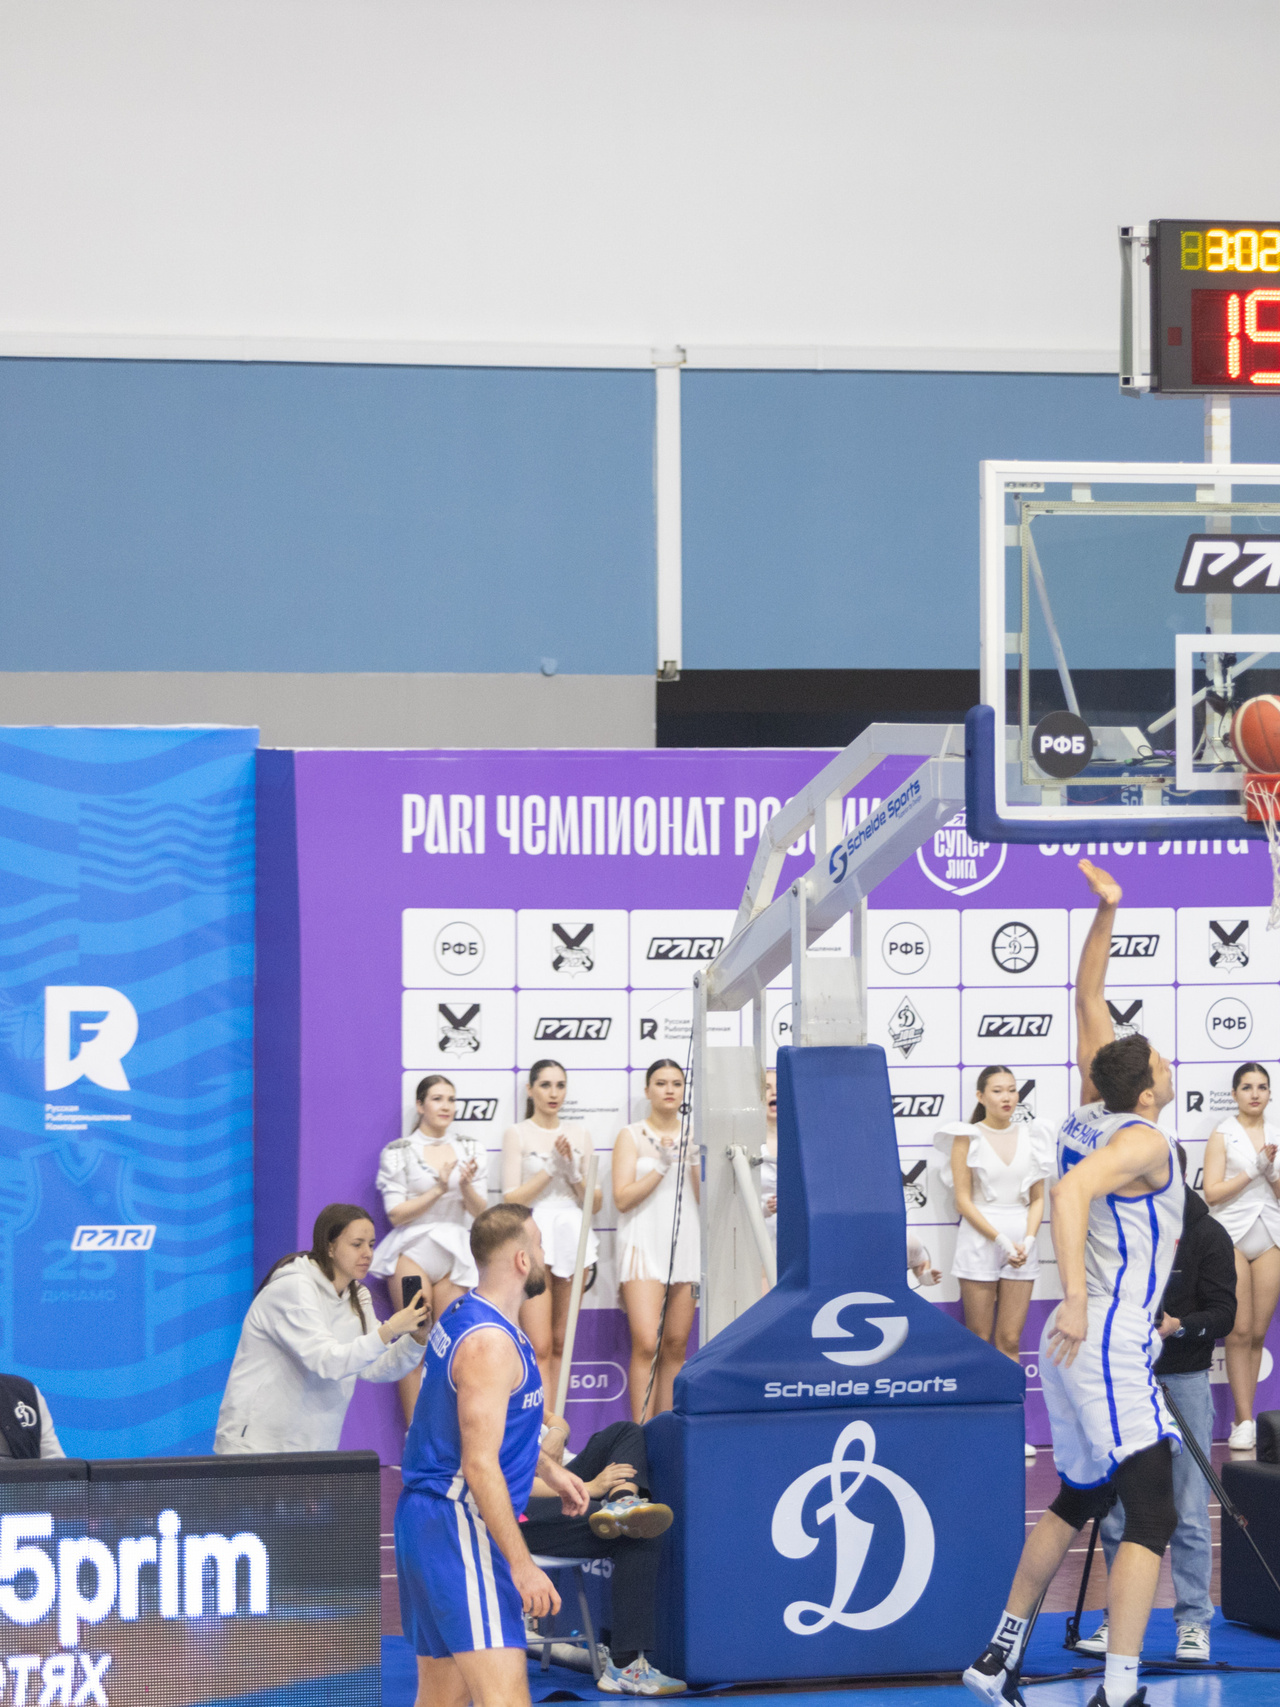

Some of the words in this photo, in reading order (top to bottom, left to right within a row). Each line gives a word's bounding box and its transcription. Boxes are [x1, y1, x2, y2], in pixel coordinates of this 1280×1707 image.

[1040, 735, 1086, 754] РФБ
[402, 793, 485, 854] PARI
[847, 811, 886, 856] Schelde
[887, 780, 921, 818] Sports
[945, 859, 978, 879] ЛИГА
[441, 942, 478, 955] РФБ
[649, 937, 723, 959] PARI
[889, 941, 924, 956] РФБ
[1110, 936, 1158, 956] ARI
[537, 1018, 611, 1039] PARI
[979, 1015, 1051, 1035] PARI
[1212, 1017, 1247, 1030] РФБ
[892, 1096, 942, 1116] ARI
[76, 1229, 151, 1247] PARI
[764, 1380, 869, 1398] Schelde
[874, 1376, 958, 1398] Sports
